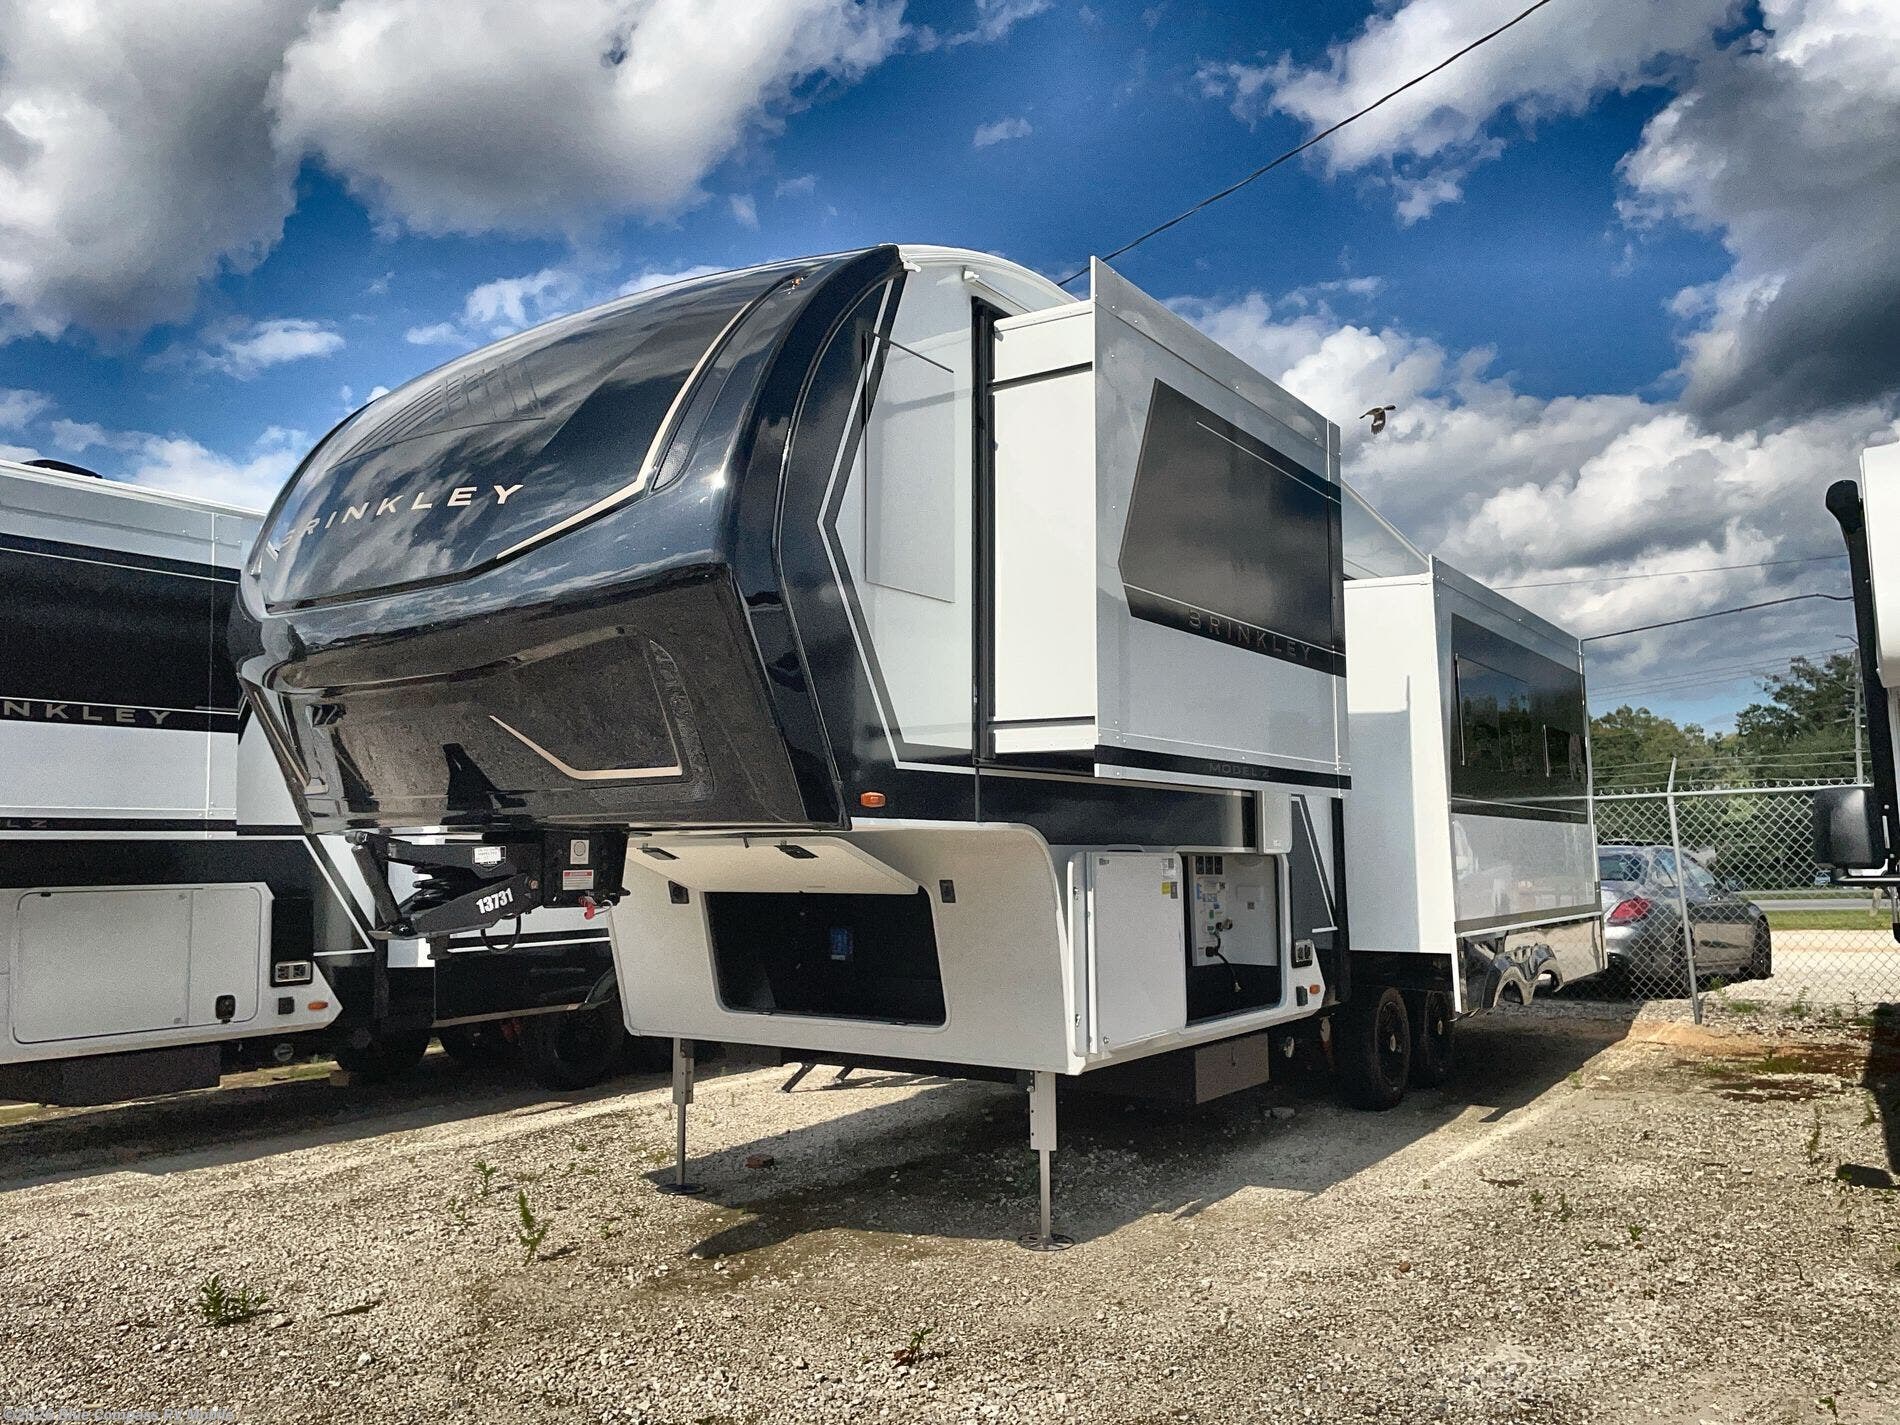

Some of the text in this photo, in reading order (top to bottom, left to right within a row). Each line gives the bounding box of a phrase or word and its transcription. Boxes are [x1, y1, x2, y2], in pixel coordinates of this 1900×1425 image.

[281, 484, 524, 548] BRINKLEY
[1187, 608, 1312, 662] BRINKLEY
[1208, 762, 1258, 777] MODEL
[475, 887, 515, 914] 13731
